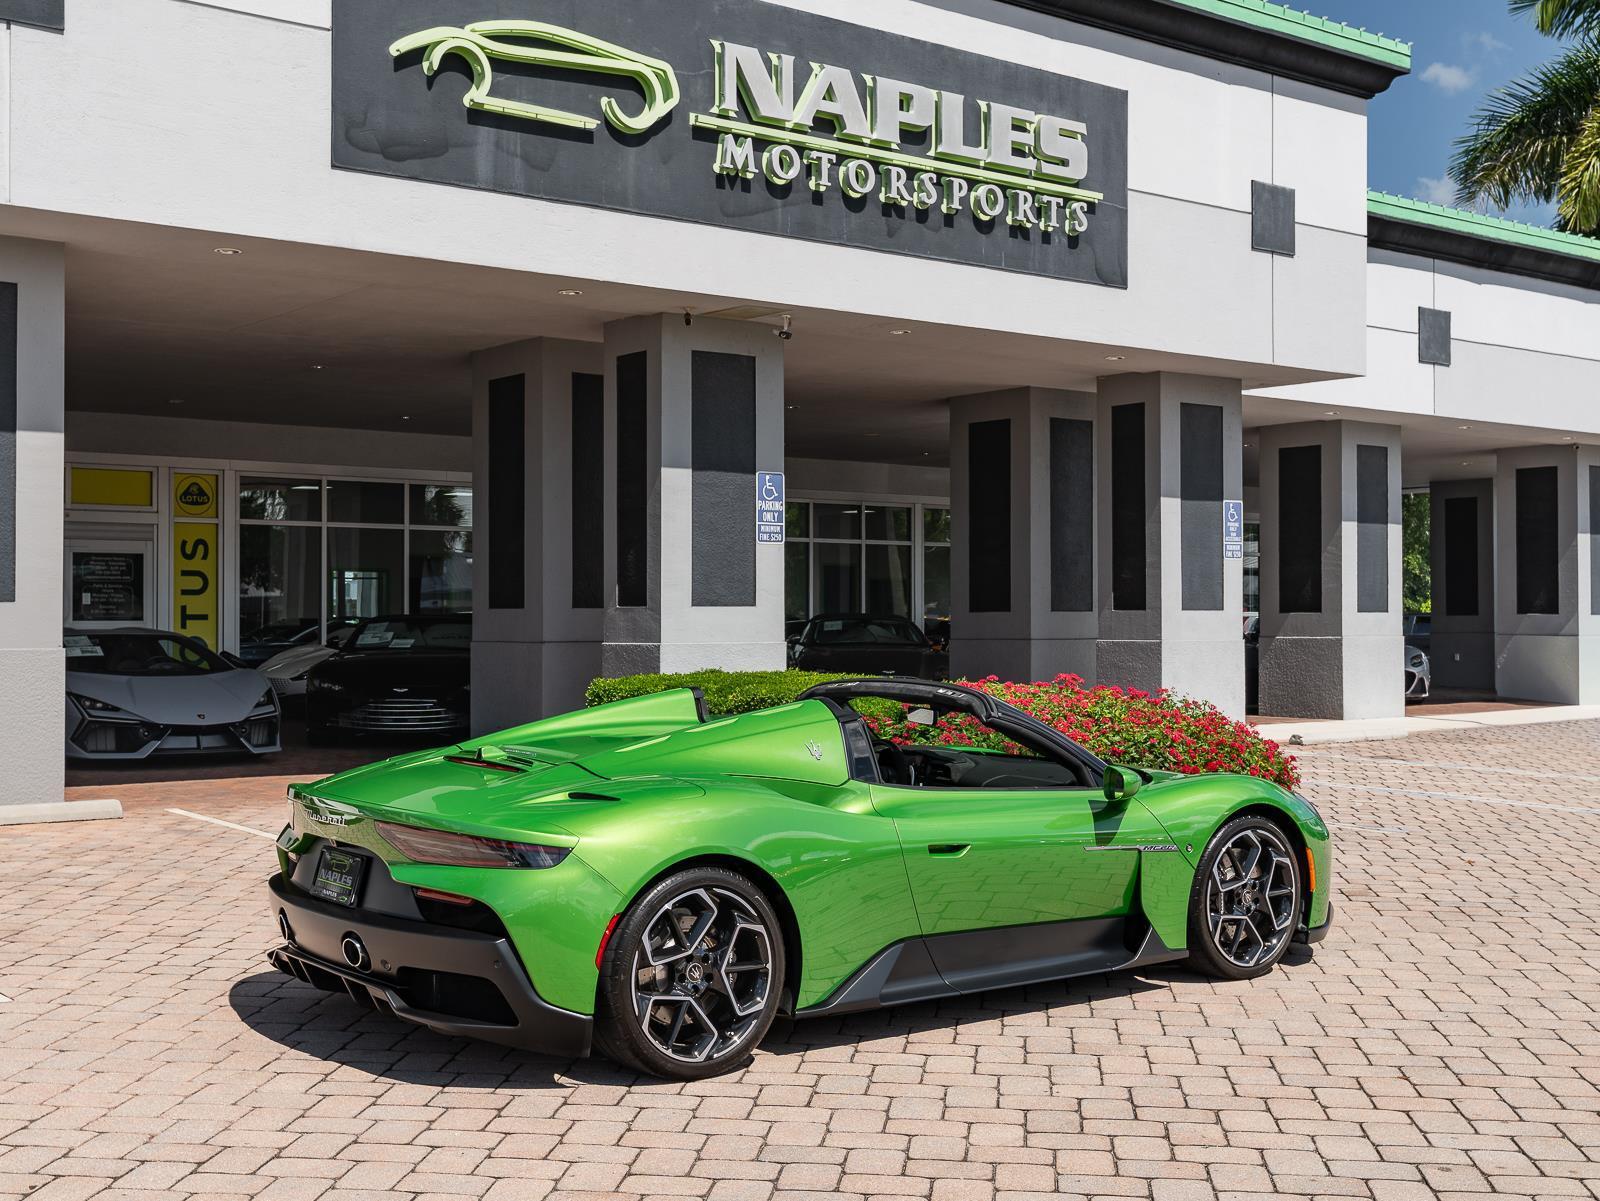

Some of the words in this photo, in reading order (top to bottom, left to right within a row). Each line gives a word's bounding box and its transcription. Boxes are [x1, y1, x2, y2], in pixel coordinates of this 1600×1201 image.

[709, 39, 1089, 185] NAPLES
[712, 133, 1089, 237] MOTORSPORTS
[181, 495, 208, 503] LOTUS
[758, 500, 783, 511] PARKING
[762, 511, 779, 522] ONLY
[759, 533, 770, 541] FINE
[180, 538, 209, 667] OTUS
[319, 868, 353, 887] NAPLES
